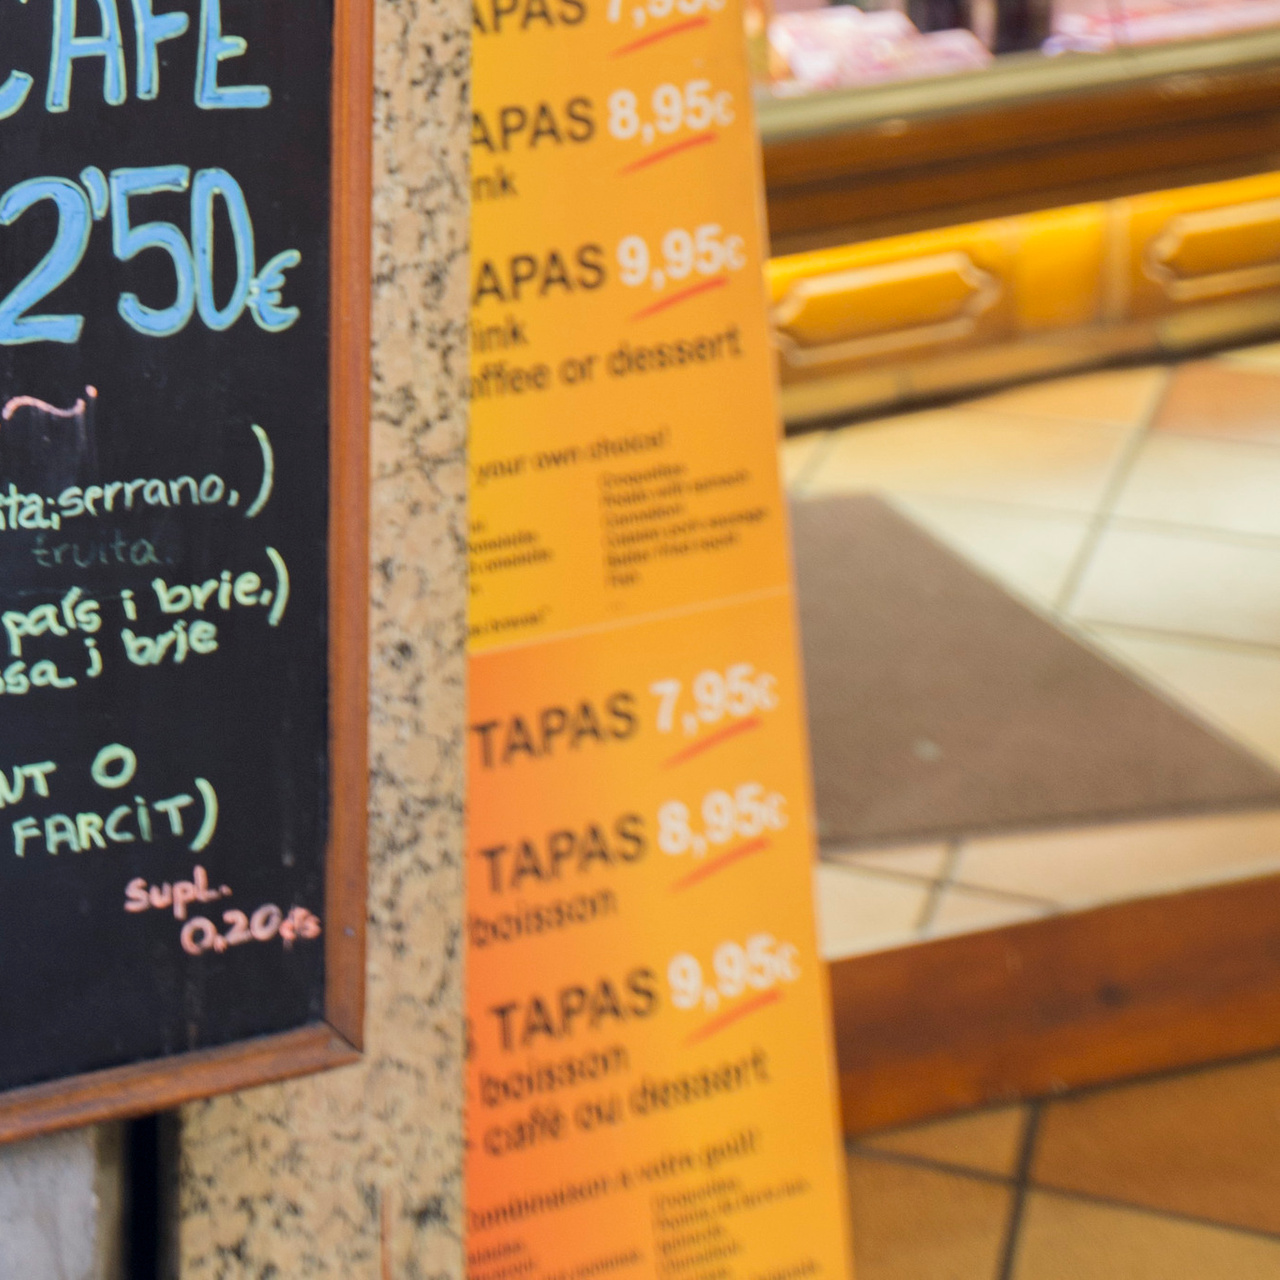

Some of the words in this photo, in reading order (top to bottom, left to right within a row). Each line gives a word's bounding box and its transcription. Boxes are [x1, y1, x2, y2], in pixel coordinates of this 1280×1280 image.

[607, 80, 735, 146] 8,95€
[617, 223, 747, 290] 9,95€
[471, 689, 639, 770] TAPAS
[649, 662, 779, 736] 7,95€
[91, 742, 138, 789] O
[479, 813, 649, 895] TAPAS
[657, 781, 789, 858] 8,95€
[488, 965, 659, 1052] TAPAS
[667, 933, 802, 1012] 9,95€
